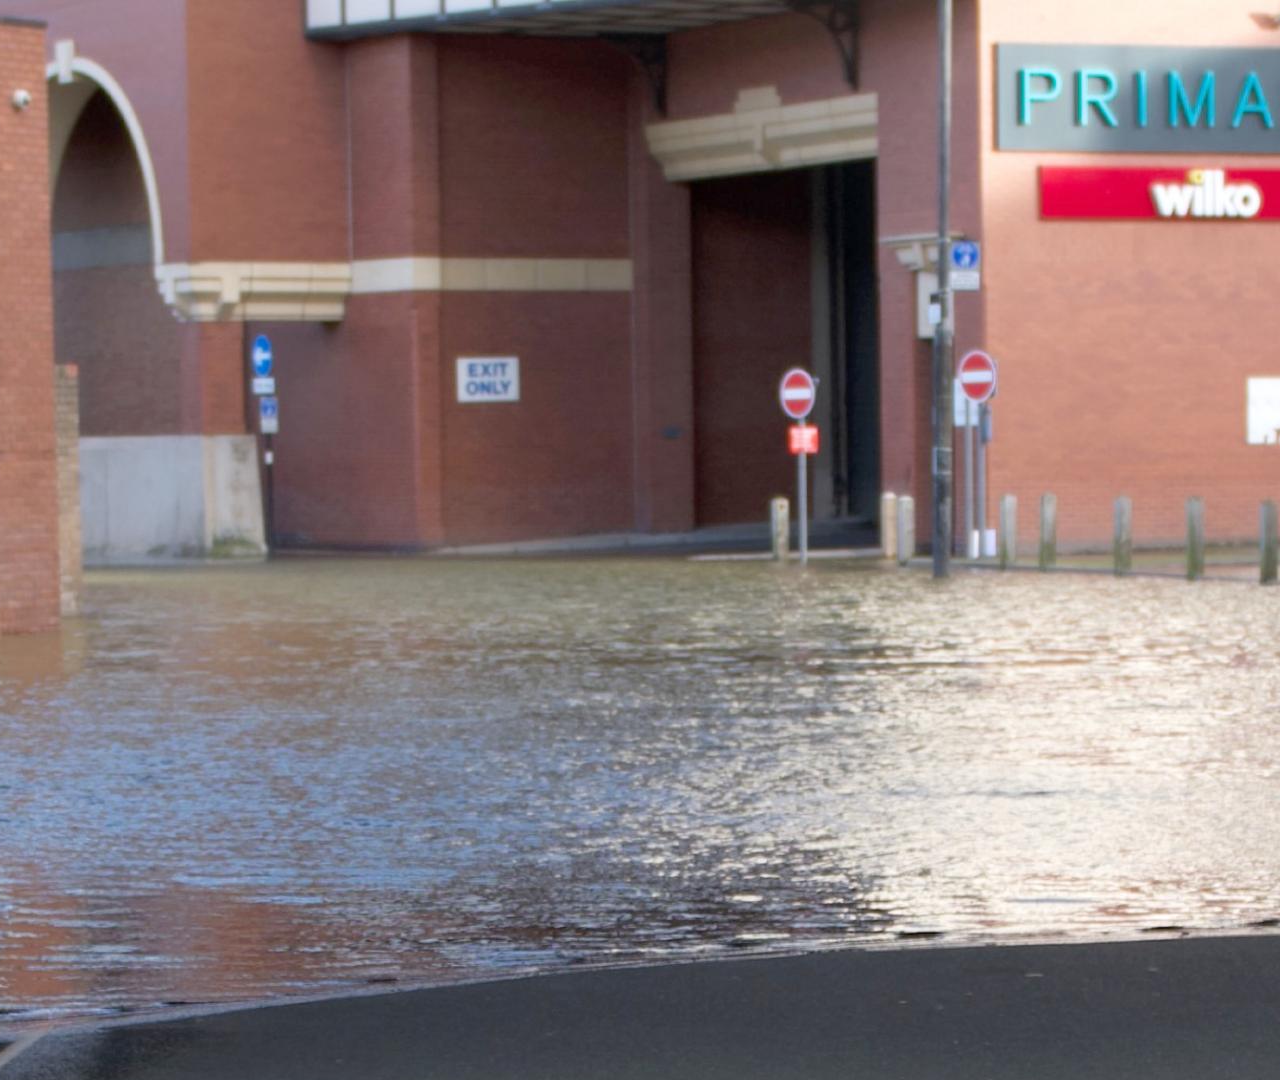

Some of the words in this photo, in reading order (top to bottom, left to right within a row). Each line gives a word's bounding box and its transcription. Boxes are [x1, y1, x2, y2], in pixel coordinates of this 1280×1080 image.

[1149, 169, 1262, 217] wilko
[467, 362, 508, 378] EXIT
[465, 380, 512, 396] ONLY
